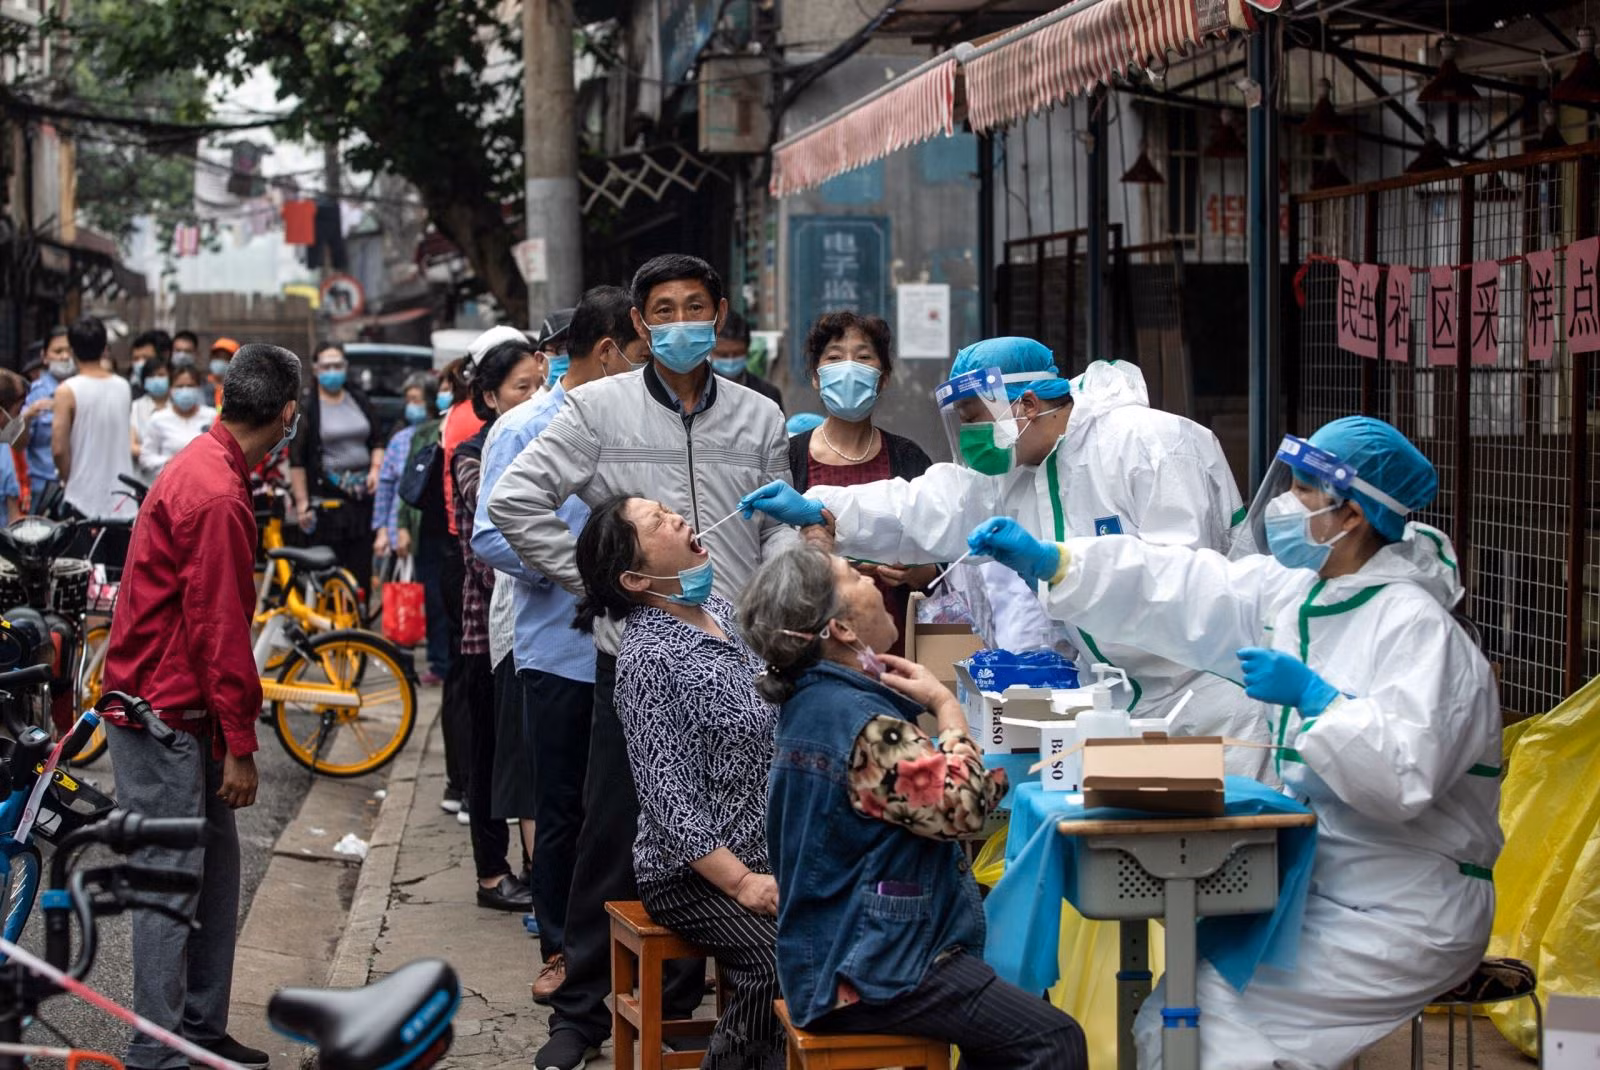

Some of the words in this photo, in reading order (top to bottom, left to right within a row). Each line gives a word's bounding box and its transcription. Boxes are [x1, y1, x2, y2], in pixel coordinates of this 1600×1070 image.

[1340, 257, 1598, 351] 民生社区采样点
